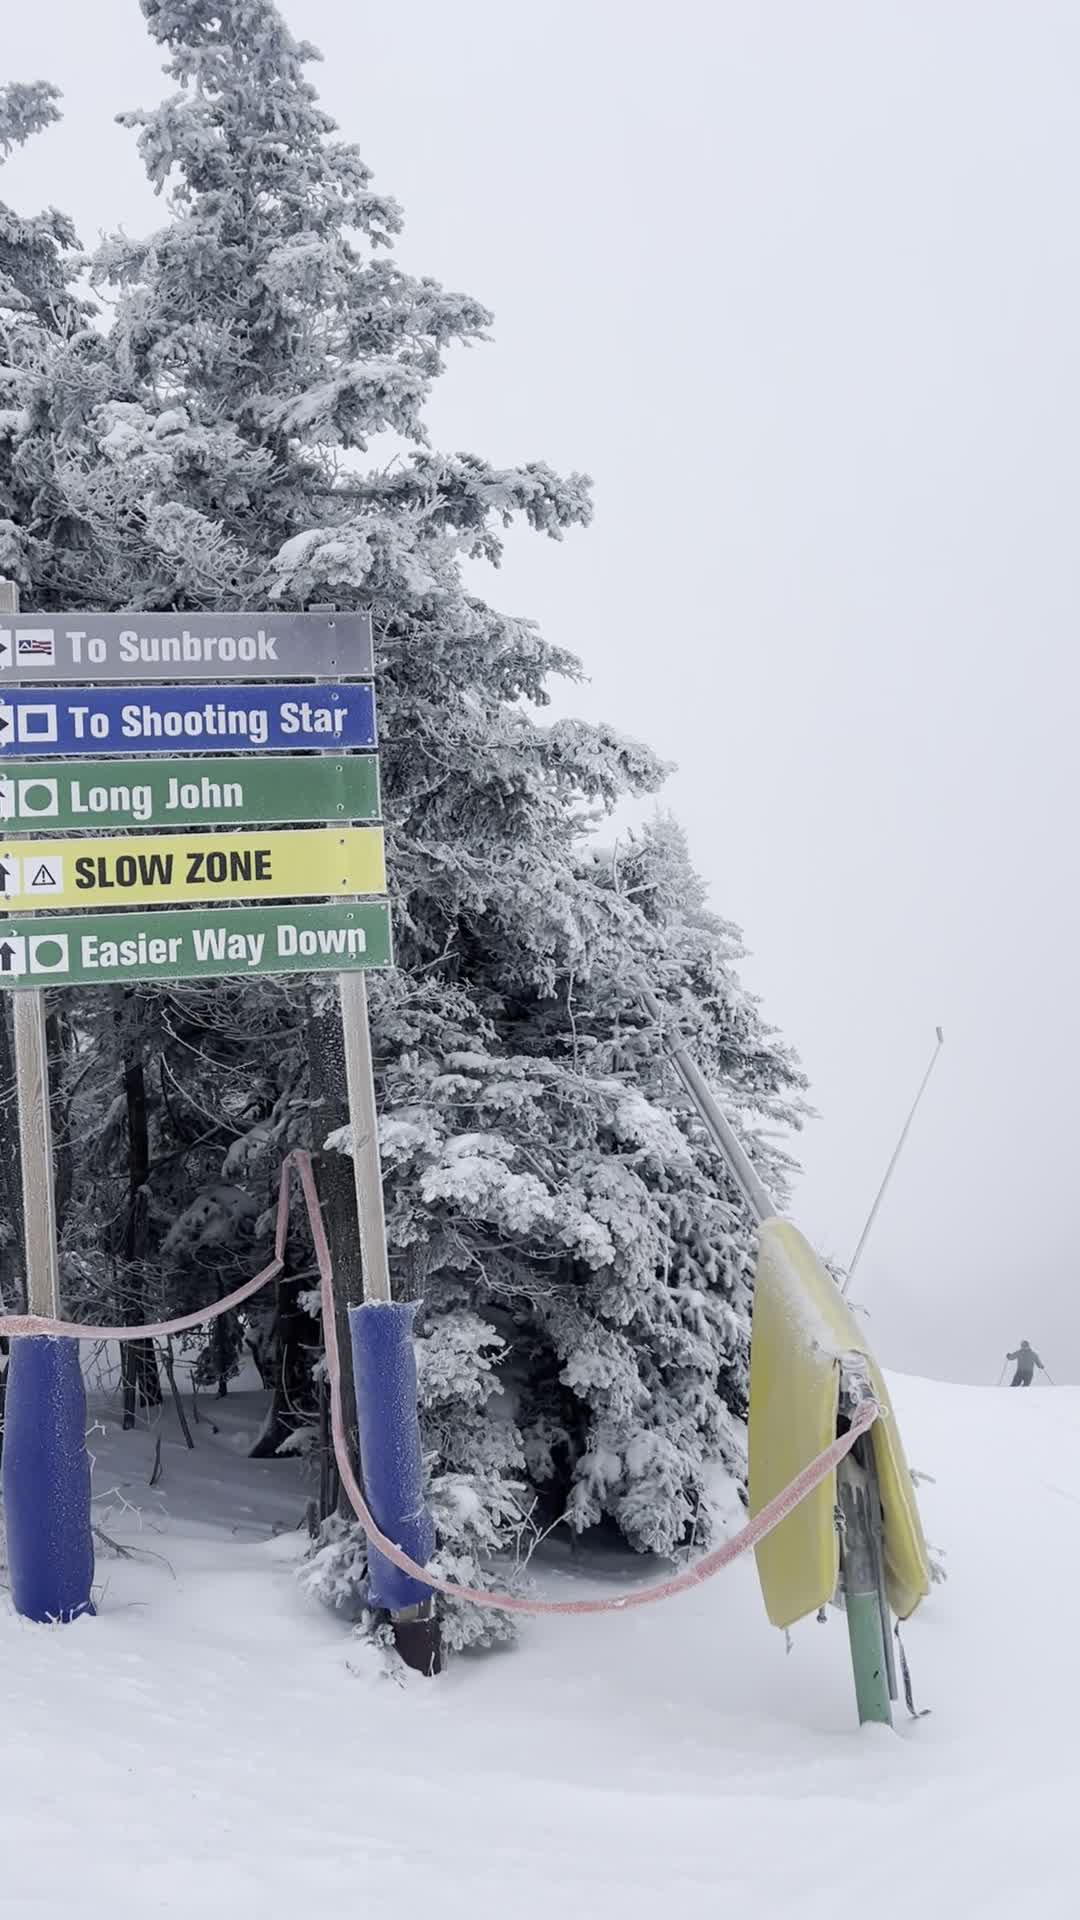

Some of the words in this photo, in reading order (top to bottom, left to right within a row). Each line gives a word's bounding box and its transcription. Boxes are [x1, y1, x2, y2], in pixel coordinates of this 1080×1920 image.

[66, 631, 106, 663] To
[120, 630, 279, 662] Sunbrook
[68, 707, 109, 738] To
[122, 704, 268, 744] Shooting
[280, 702, 347, 733] Star
[70, 780, 152, 820] Long
[166, 777, 243, 809] John
[75, 854, 173, 888] SLOW
[186, 850, 272, 884] ZONE
[80, 933, 182, 968] Easier
[192, 928, 265, 965] Way
[277, 925, 366, 956] Down
